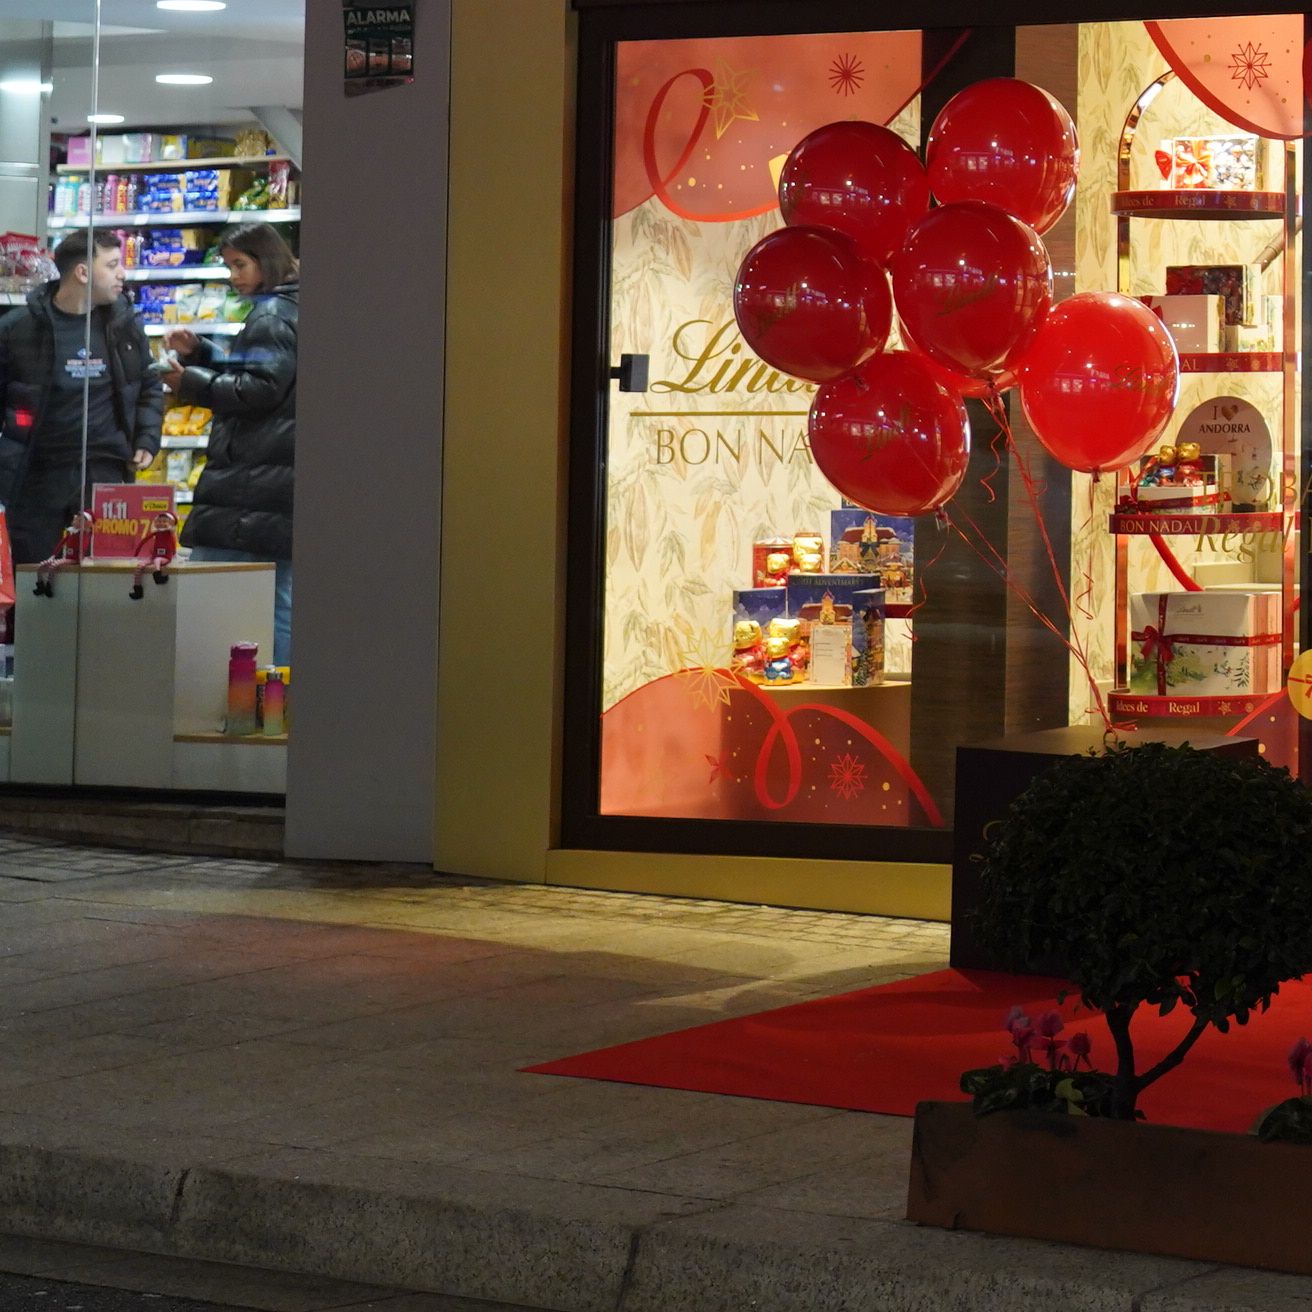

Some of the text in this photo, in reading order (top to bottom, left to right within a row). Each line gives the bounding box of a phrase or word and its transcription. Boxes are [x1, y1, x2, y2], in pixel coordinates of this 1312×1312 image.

[346, 8, 412, 26] ALARMA
[650, 319, 816, 394] Lin
[1212, 405, 1218, 421] I
[1200, 423, 1251, 434] ANDORRA
[656, 428, 741, 465] BON
[95, 518, 139, 537] PROMO
[1120, 520, 1200, 533] BON NADAL
[1195, 514, 1293, 564] Regal
[1136, 701, 1149, 713] de
[1168, 701, 1200, 716] Regal
